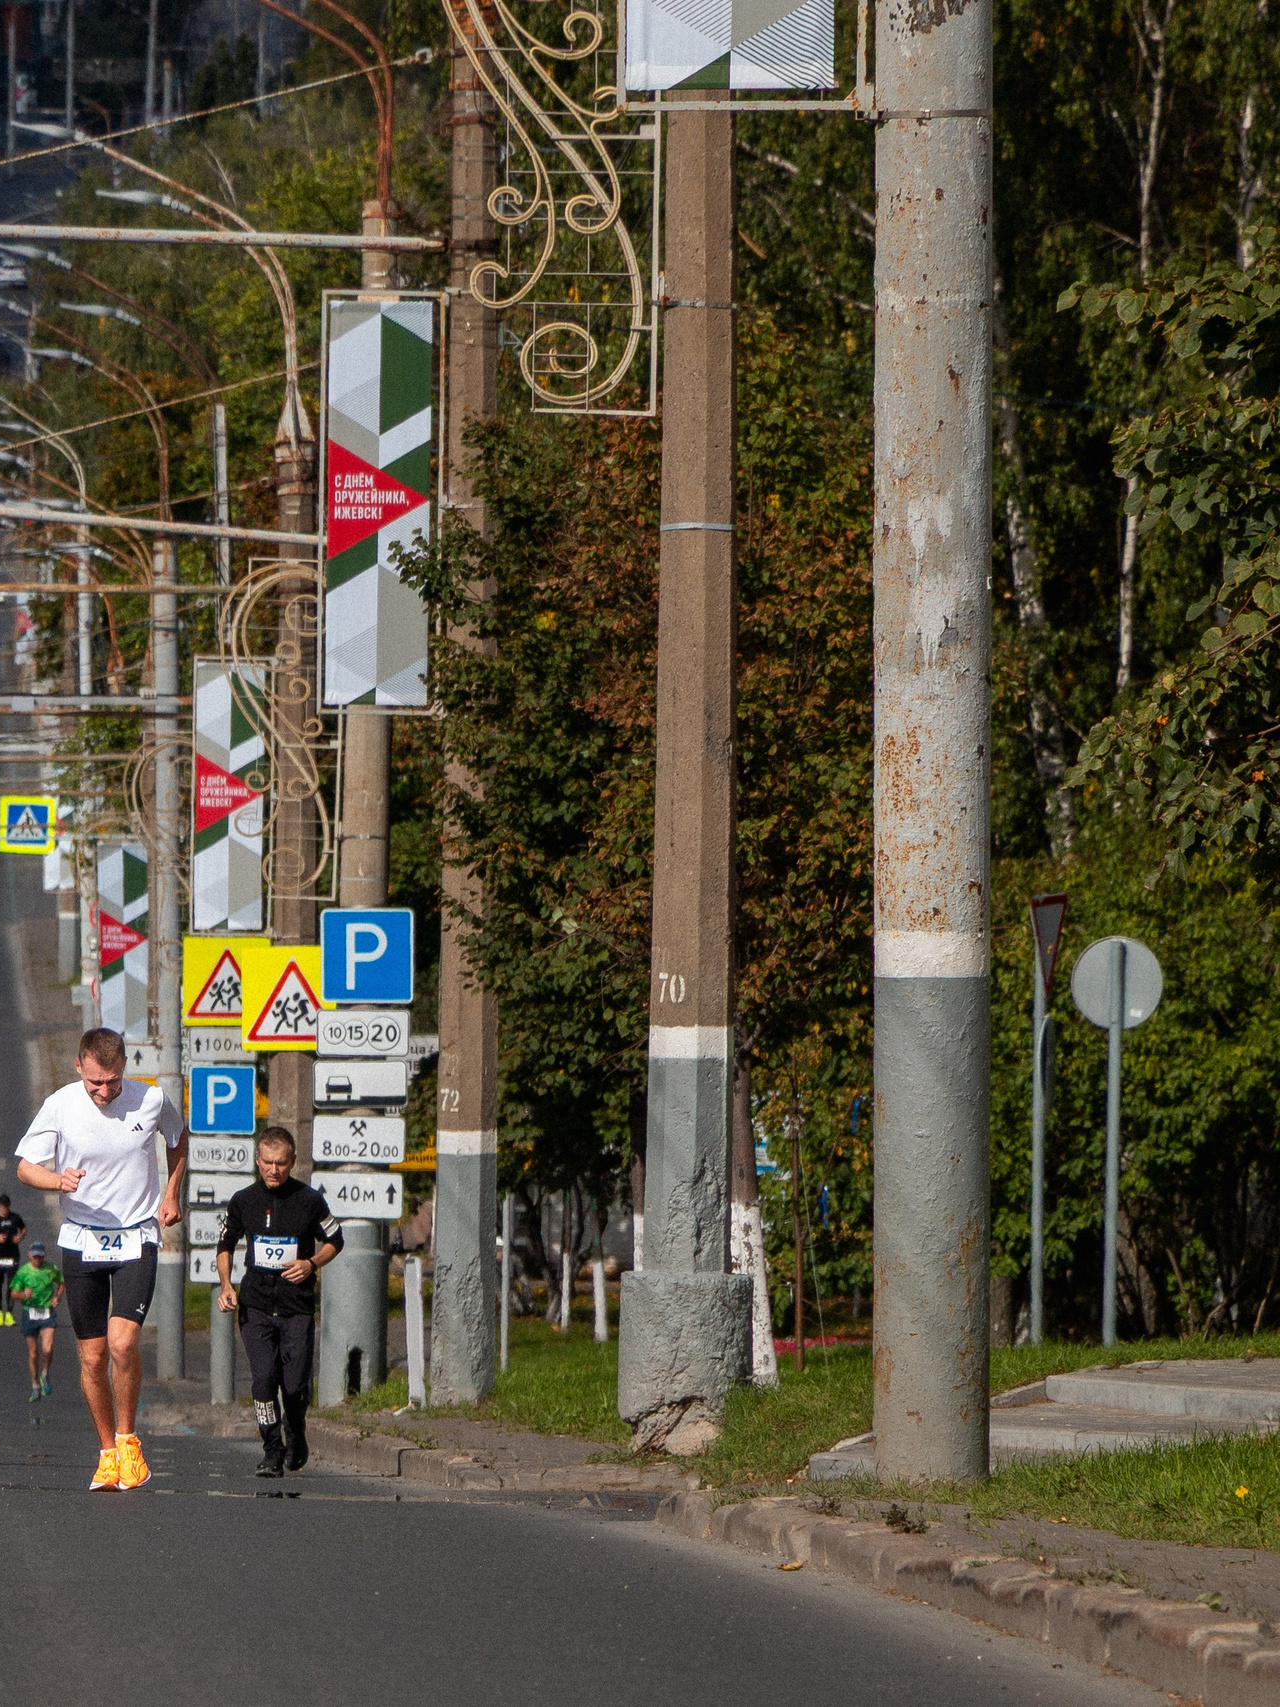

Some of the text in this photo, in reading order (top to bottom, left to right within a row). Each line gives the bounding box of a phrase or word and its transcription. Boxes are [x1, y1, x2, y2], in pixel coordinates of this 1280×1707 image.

[334, 473, 374, 489] С ДНЁМ
[334, 488, 410, 506] ОРУЖЕЙНИКА,
[334, 506, 383, 520] ИЖЕВСК!
[346, 923, 388, 990] P
[658, 972, 686, 1004] 70
[328, 1024, 398, 1043] 10 15 20
[207, 1075, 237, 1125] P
[440, 1087, 460, 1113] 72
[210, 1150, 222, 1160] 15
[227, 1148, 246, 1163] 20
[100, 1234, 123, 1251] 24
[265, 1247, 285, 1260] 99
